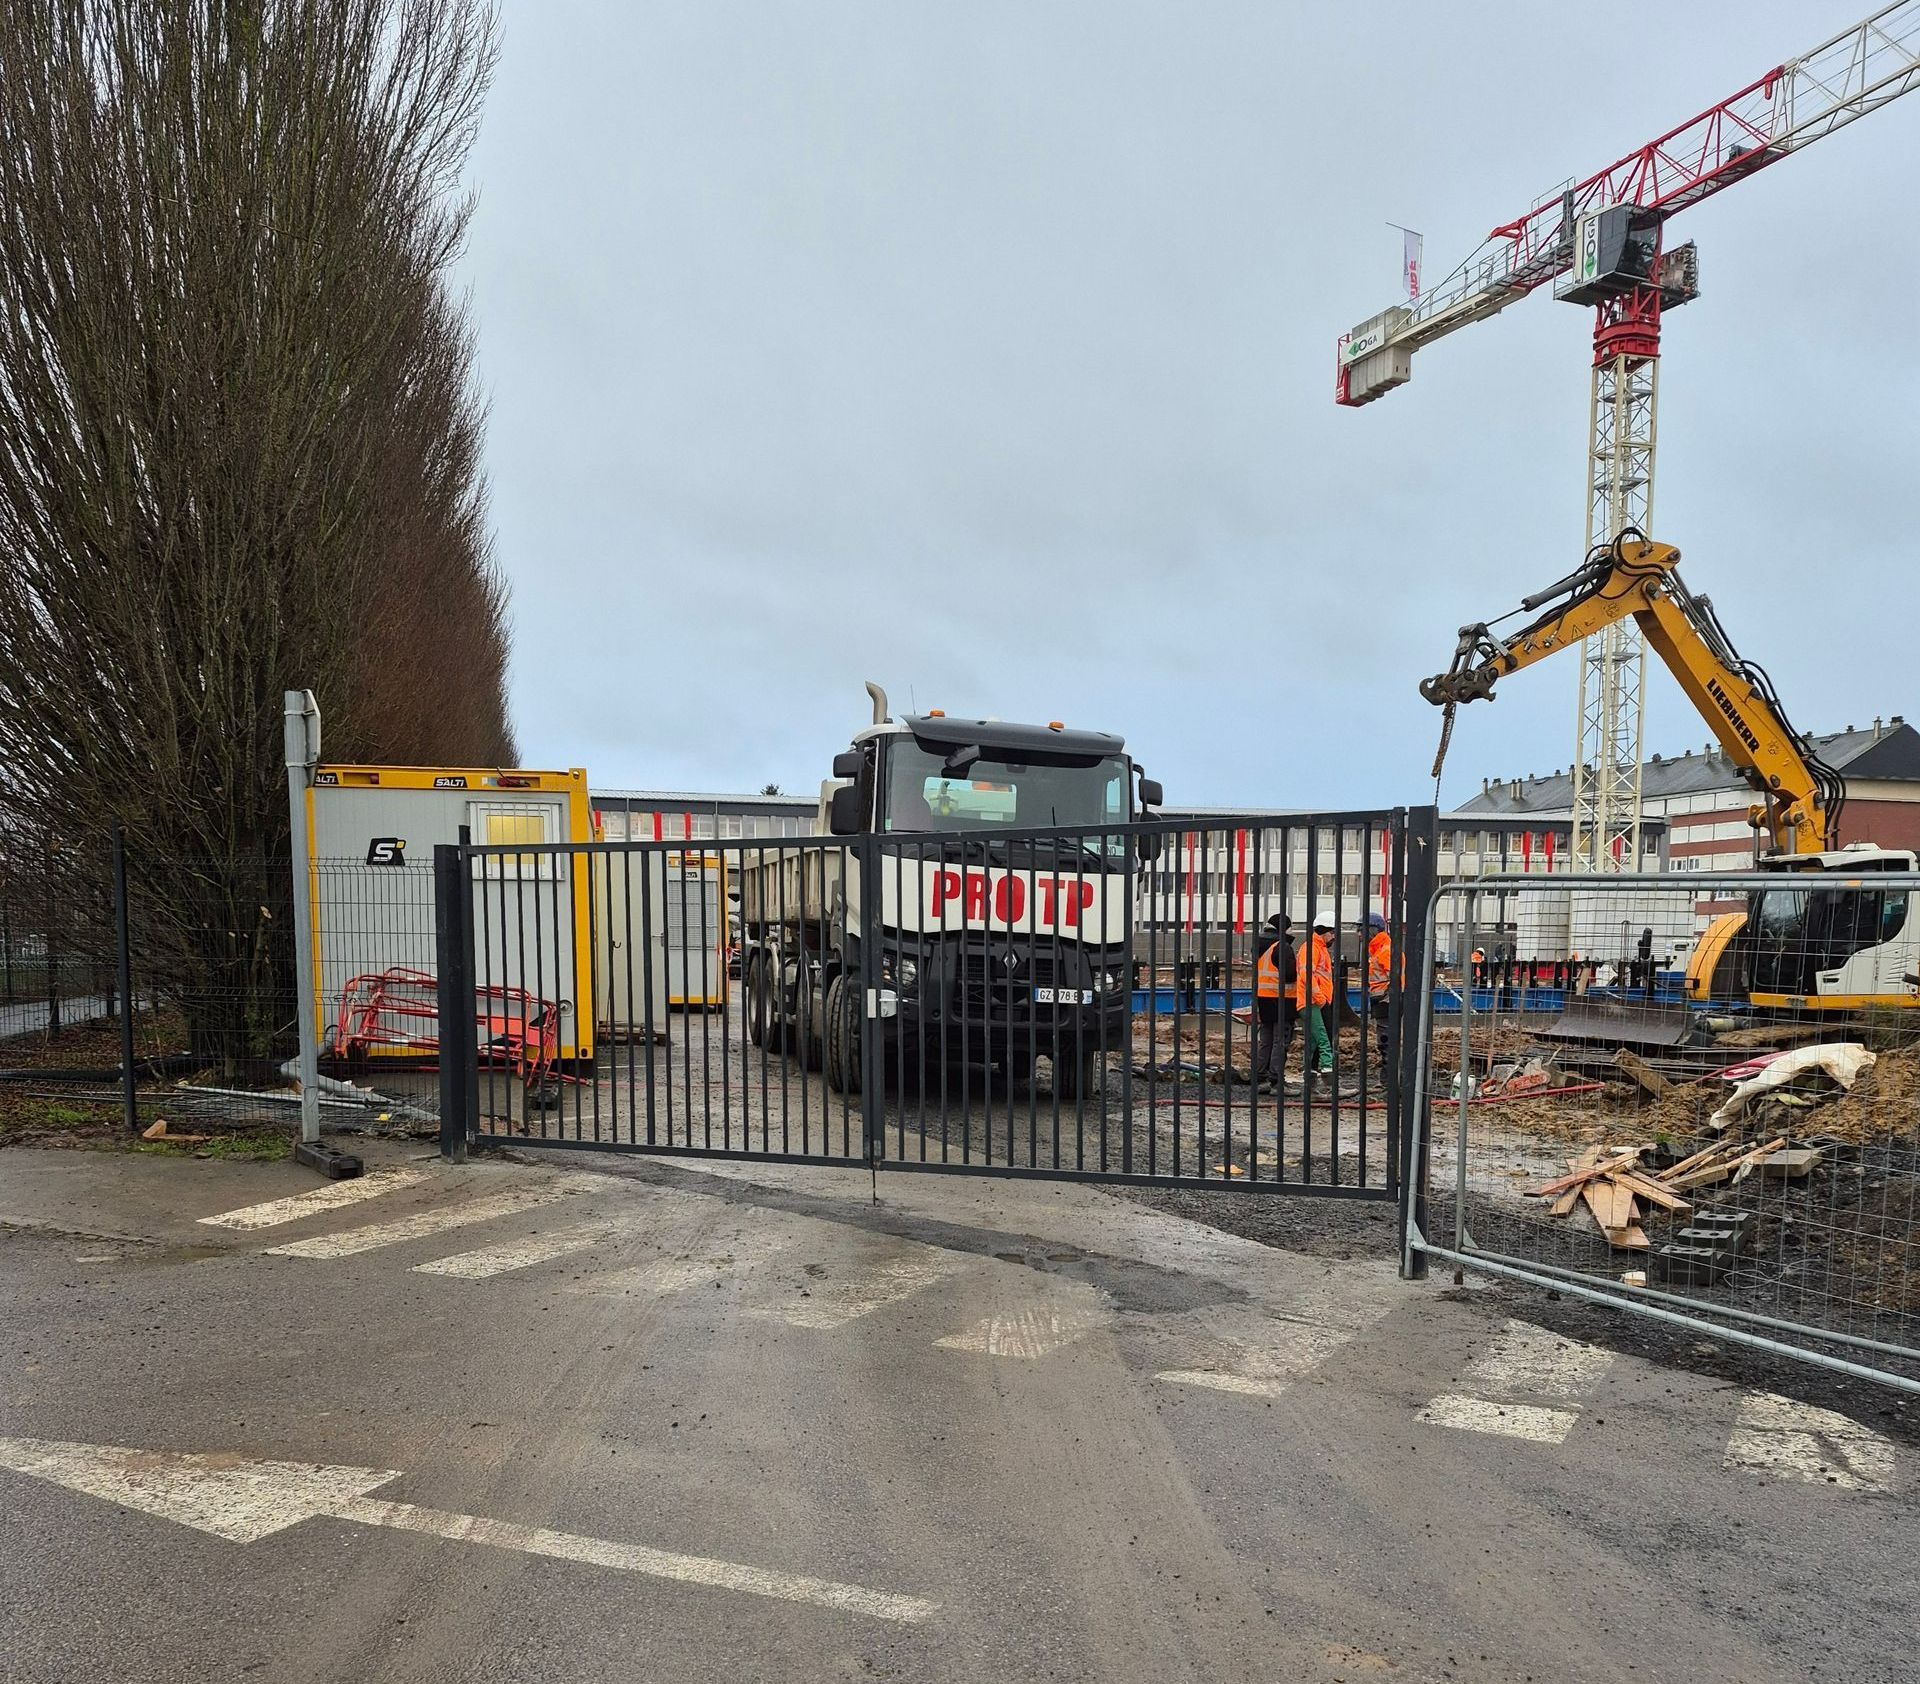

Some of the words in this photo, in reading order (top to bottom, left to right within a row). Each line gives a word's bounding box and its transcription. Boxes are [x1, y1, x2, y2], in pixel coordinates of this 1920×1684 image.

[1706, 678, 1760, 754] LIEBHERR
[316, 774, 336, 784] ALTI
[435, 778, 465, 787] SALTI
